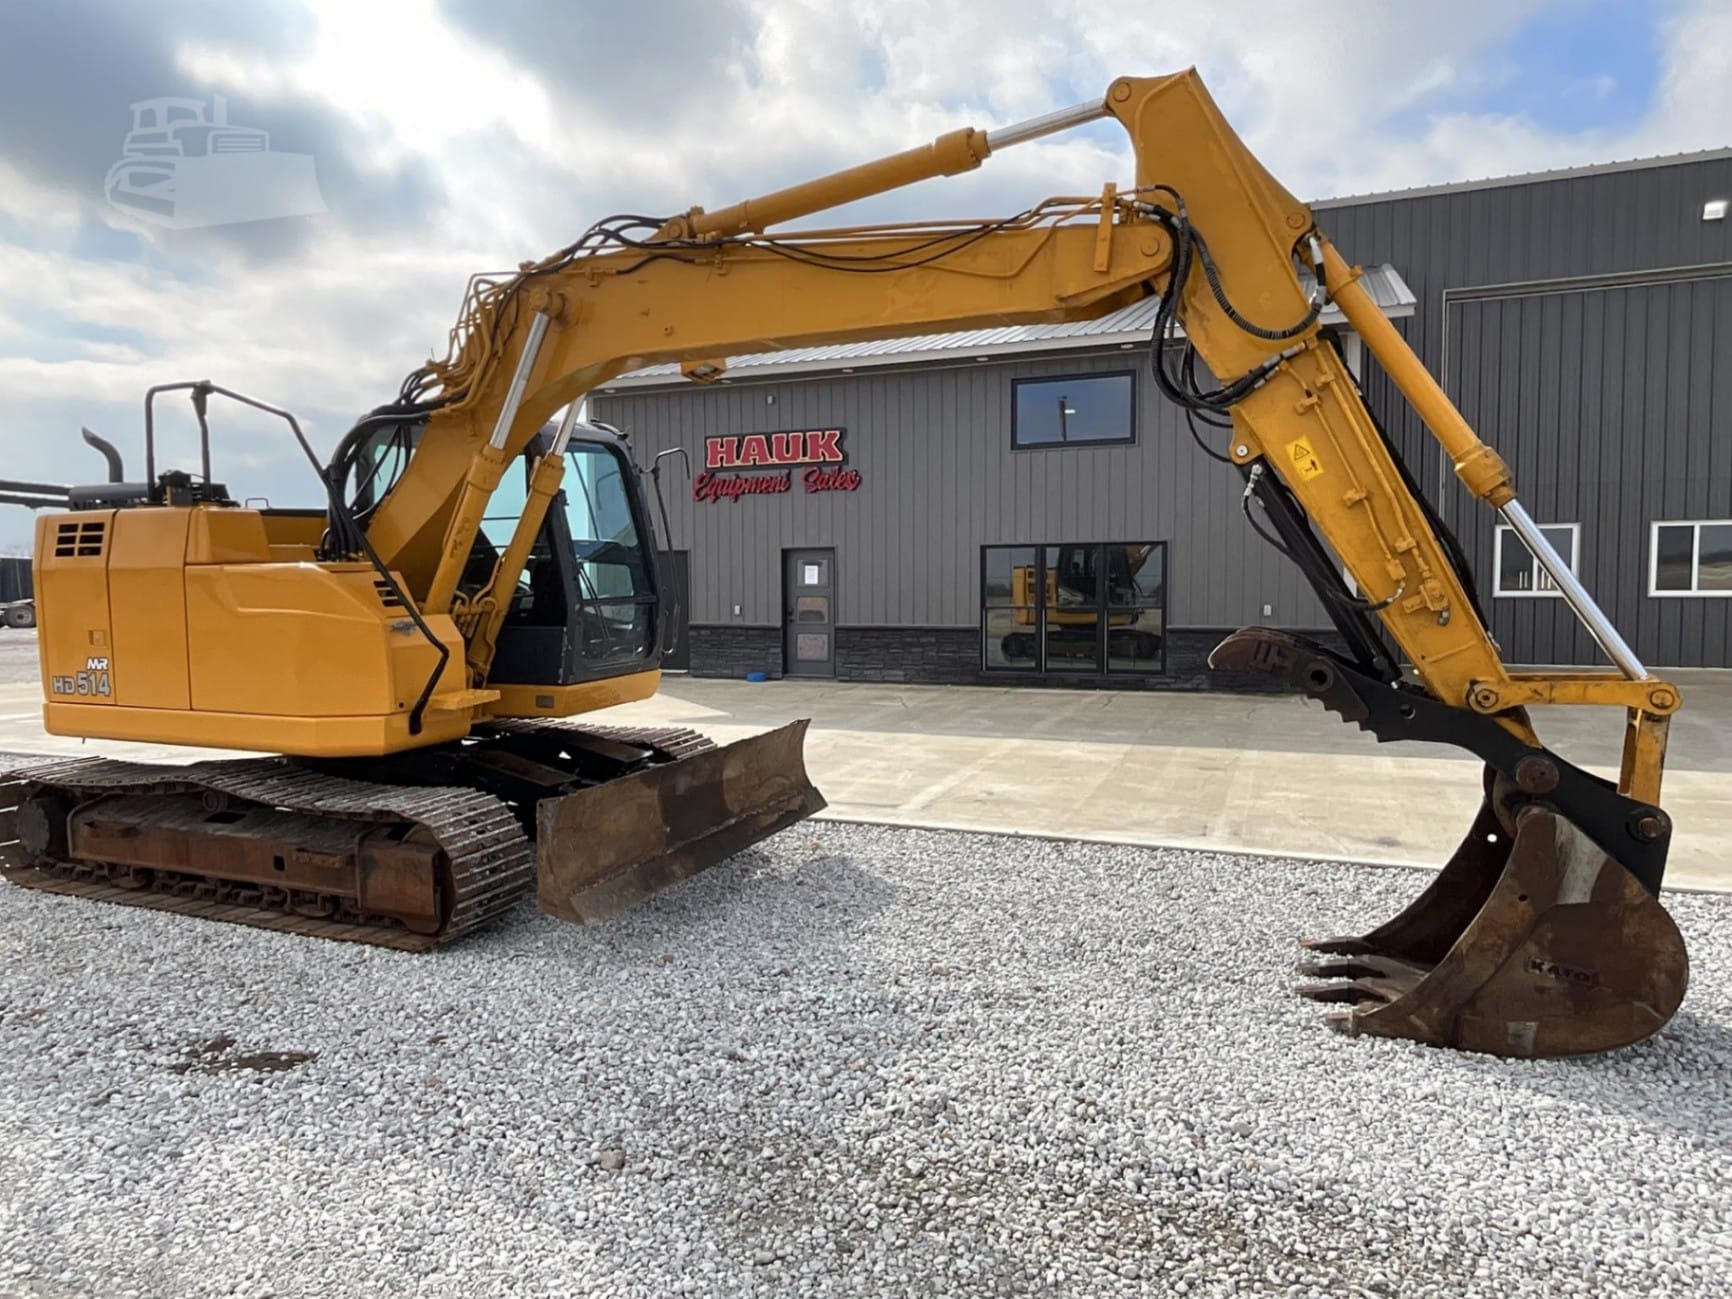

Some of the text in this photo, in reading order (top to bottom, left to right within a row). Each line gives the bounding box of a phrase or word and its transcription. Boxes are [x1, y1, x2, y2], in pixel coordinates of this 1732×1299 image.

[706, 430, 843, 468] HAUK
[693, 466, 861, 503] Equipment Sales
[87, 658, 108, 670] MR
[53, 671, 111, 696] HD514
